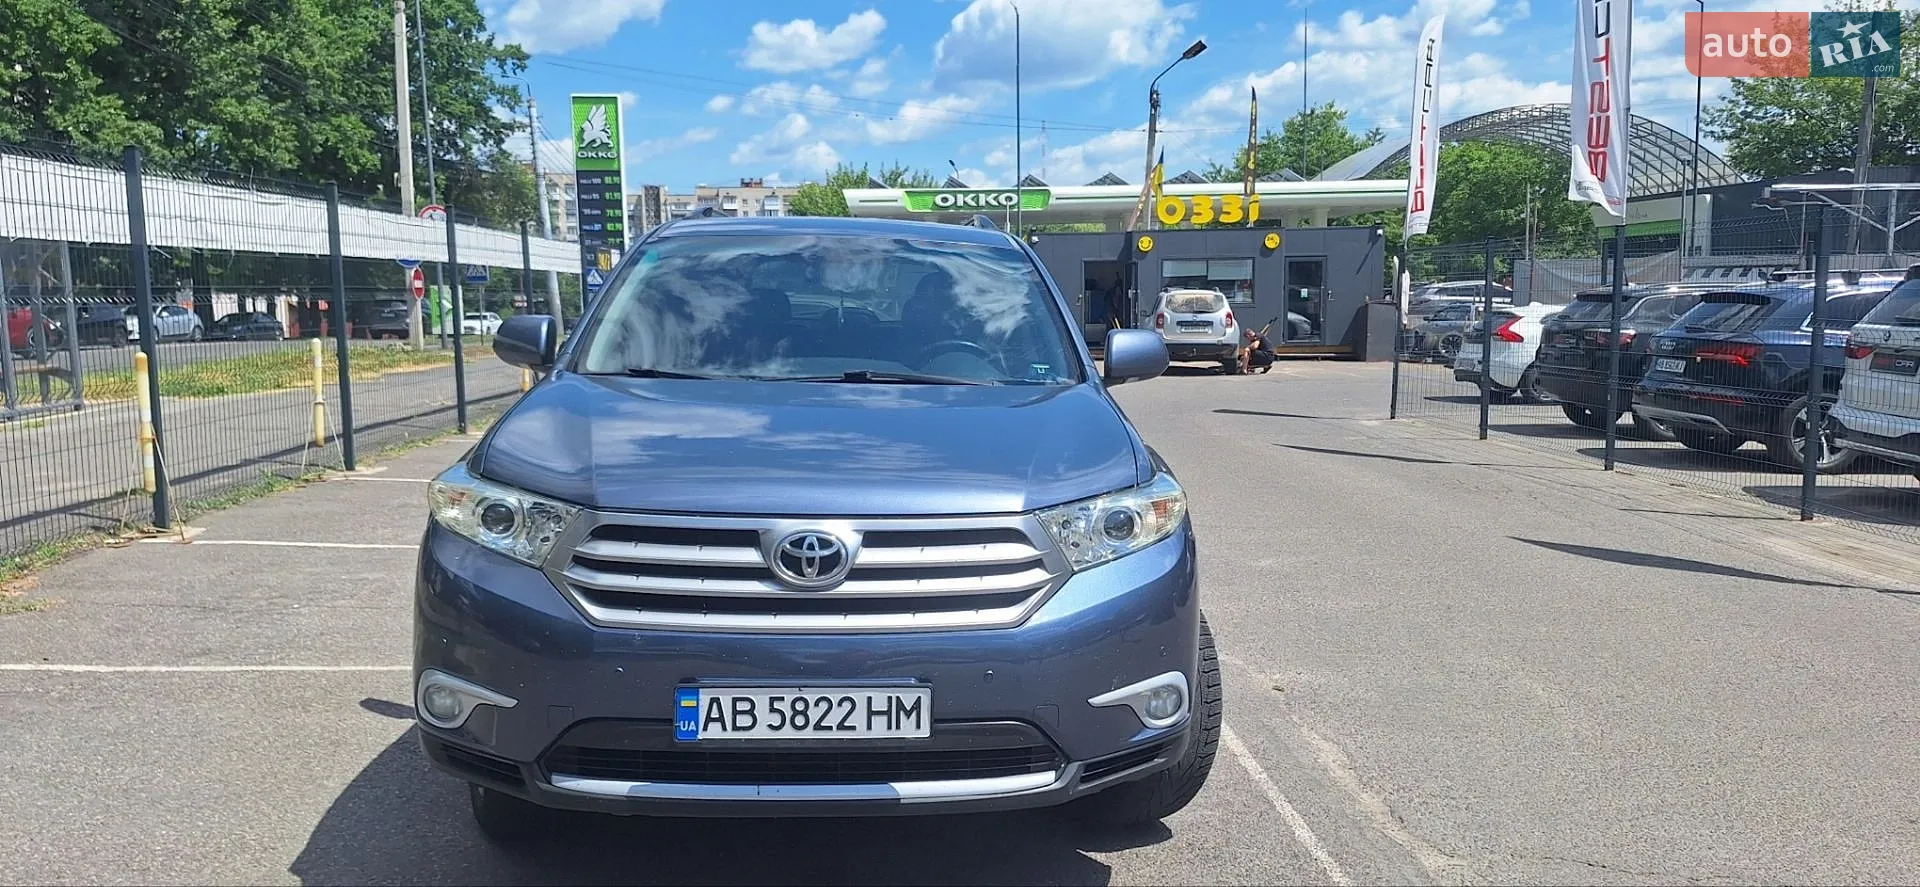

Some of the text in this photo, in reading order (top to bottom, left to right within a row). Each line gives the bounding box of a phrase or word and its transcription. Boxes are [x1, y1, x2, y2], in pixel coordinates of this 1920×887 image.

[577, 150, 618, 159] OKKO
[934, 192, 1018, 208] OKKO
[702, 695, 921, 732] AB 5822 HM
[680, 721, 697, 732] UA
